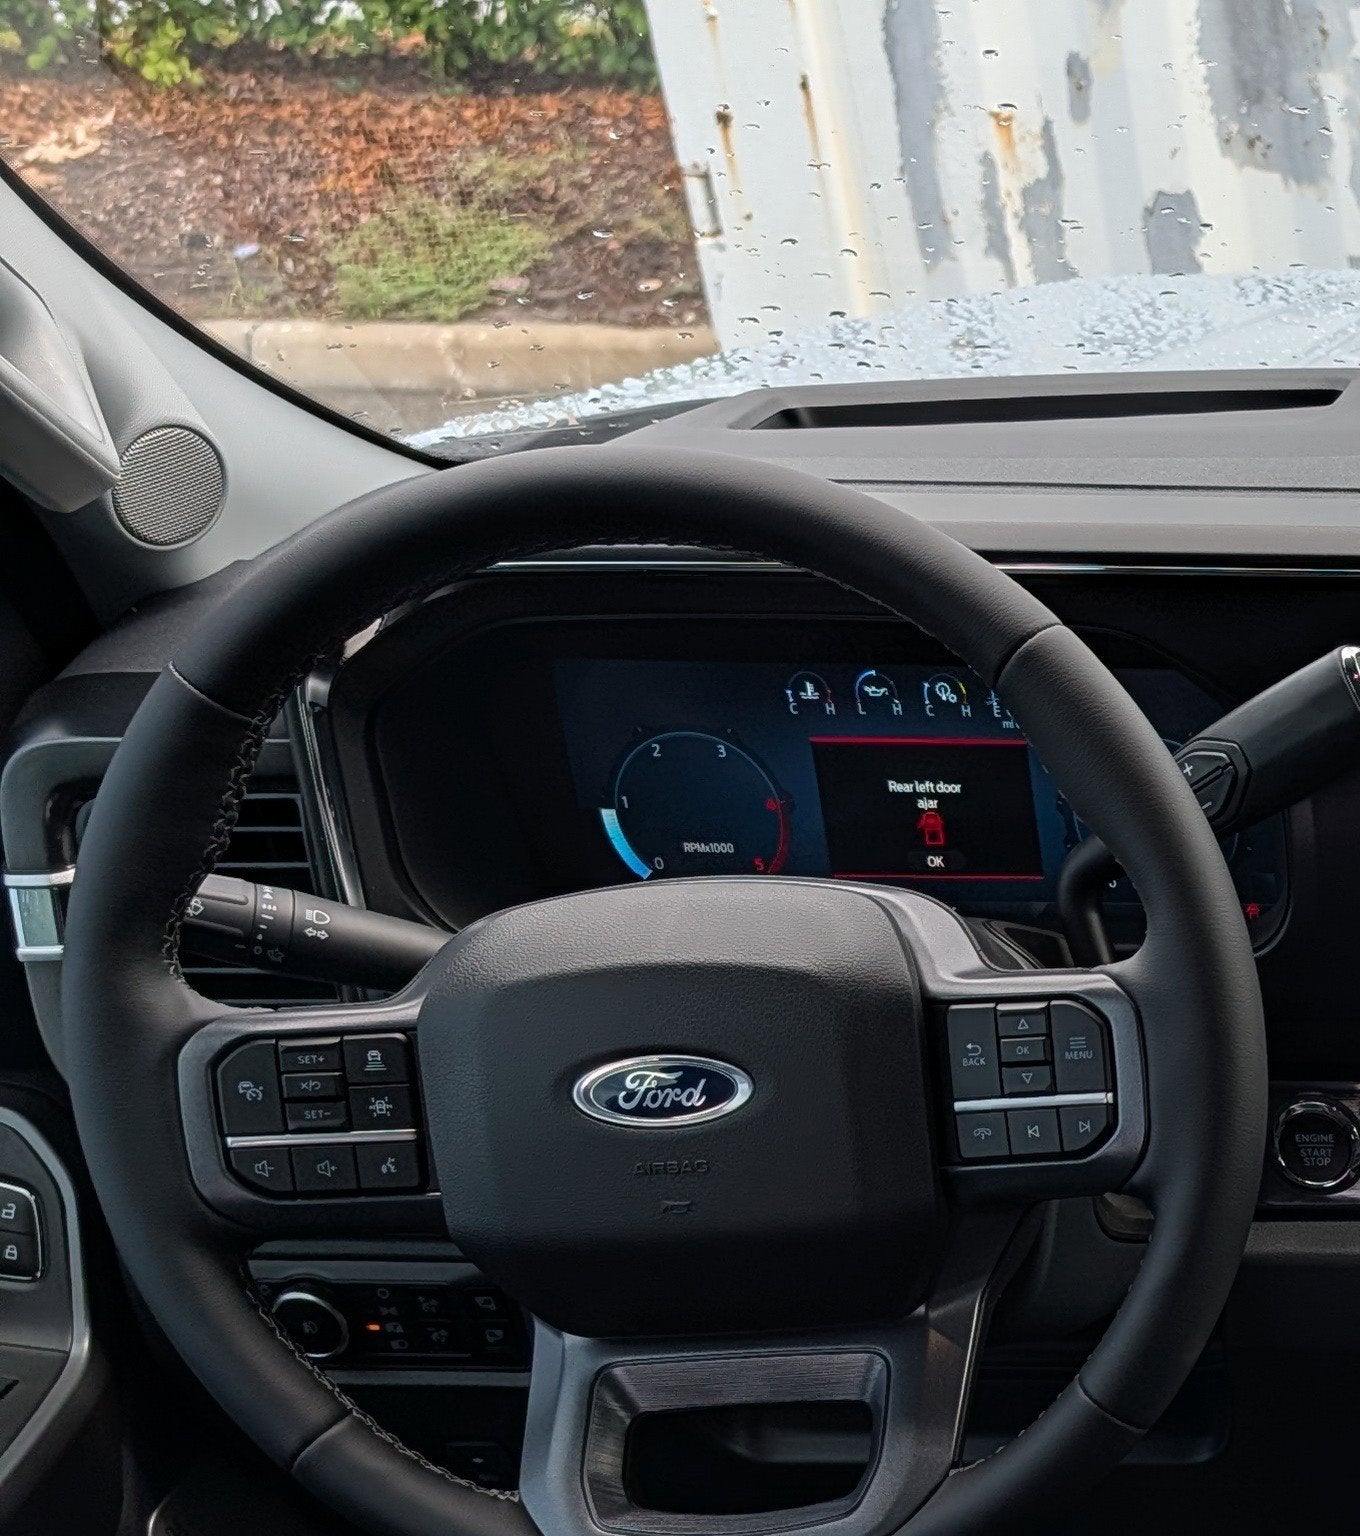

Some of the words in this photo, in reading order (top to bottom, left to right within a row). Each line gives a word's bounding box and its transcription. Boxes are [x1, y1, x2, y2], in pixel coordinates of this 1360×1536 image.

[789, 703, 799, 714] C
[825, 703, 836, 715] H
[857, 703, 867, 715] L
[893, 703, 903, 716] H
[925, 704, 935, 716] C
[961, 705, 972, 717] H
[651, 743, 662, 757] 2
[717, 744, 727, 758] 3
[888, 780, 914, 793] Rear
[915, 780, 935, 793] left
[936, 780, 962, 794] door
[621, 795, 629, 809] 1
[917, 796, 938, 811] ajar
[654, 857, 665, 870] 0
[927, 856, 944, 868] OK
[1016, 1045, 1030, 1054] OK
[1065, 1050, 1093, 1060] MENU
[963, 1057, 986, 1067] BACK
[618, 1071, 707, 1110] Ford
[1295, 1133, 1334, 1143] ENGINE
[1300, 1148, 1332, 1157] START
[1303, 1157, 1331, 1166] STOP
